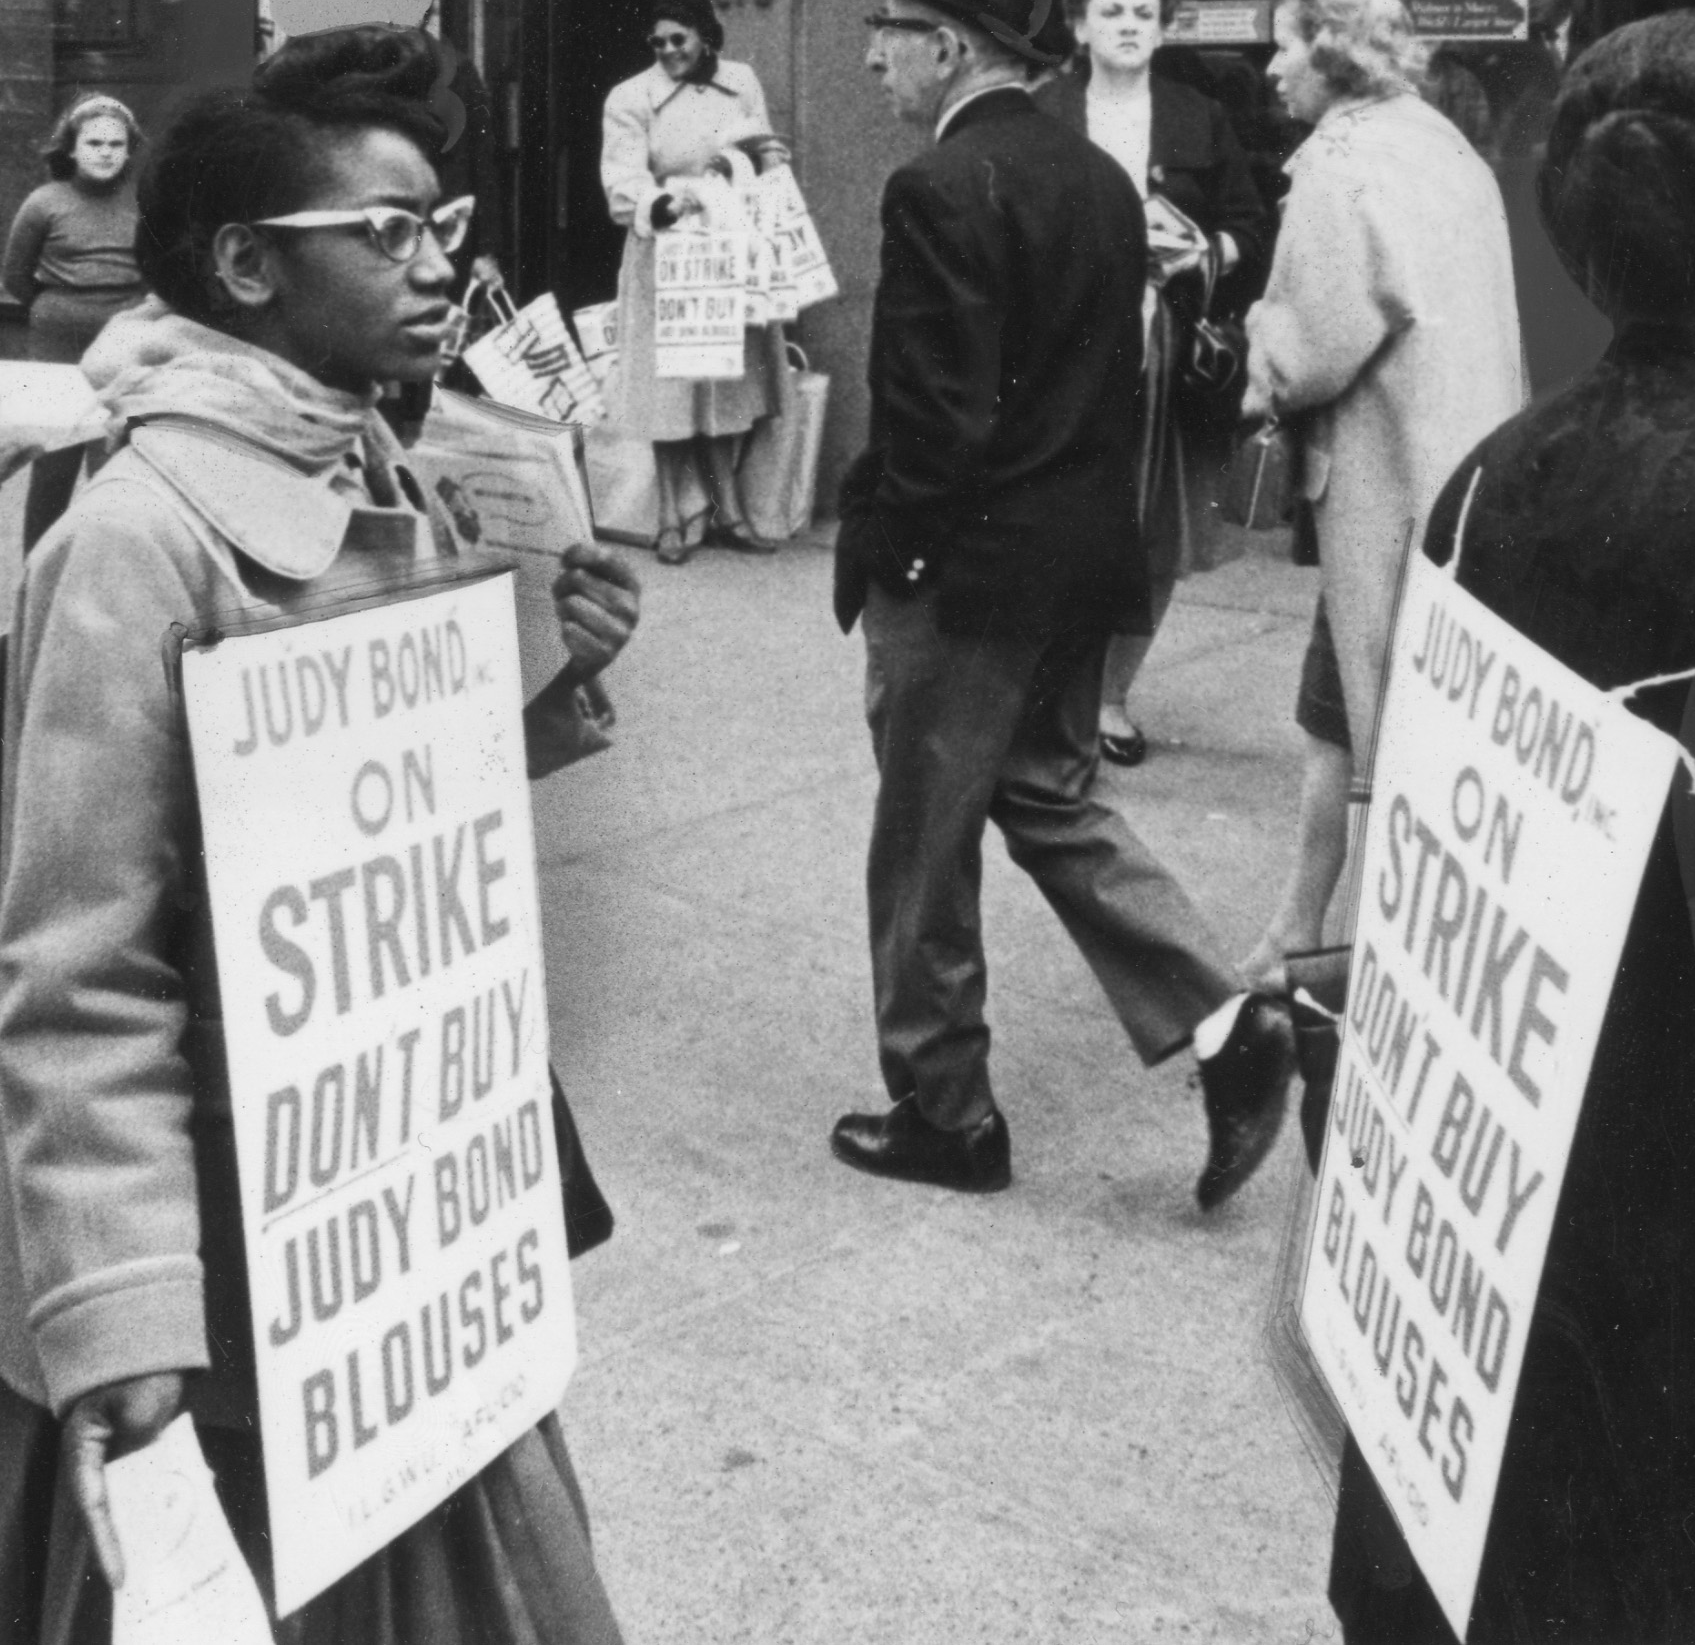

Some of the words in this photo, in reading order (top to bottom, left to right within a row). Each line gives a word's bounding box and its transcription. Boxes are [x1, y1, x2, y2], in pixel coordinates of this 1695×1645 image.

[233, 644, 353, 757] JUDY
[350, 743, 435, 837] ON
[1412, 600, 1496, 720] JUDY
[1490, 663, 1597, 823] BOND,
[258, 808, 510, 1038] STRIKE
[1451, 765, 1524, 885] ON
[438, 967, 528, 1124] BUY
[1377, 792, 1571, 1111] STRIKE
[1349, 940, 1442, 1125] DON'T
[1431, 1069, 1545, 1257] BUY
[268, 1172, 415, 1349] JUDY
[433, 1098, 543, 1249] BOND
[1322, 1176, 1475, 1505] BLOUSES
[1334, 1059, 1407, 1226] JUDY
[1405, 1177, 1511, 1395] BOND
[303, 1227, 545, 1481] BLOUSES
